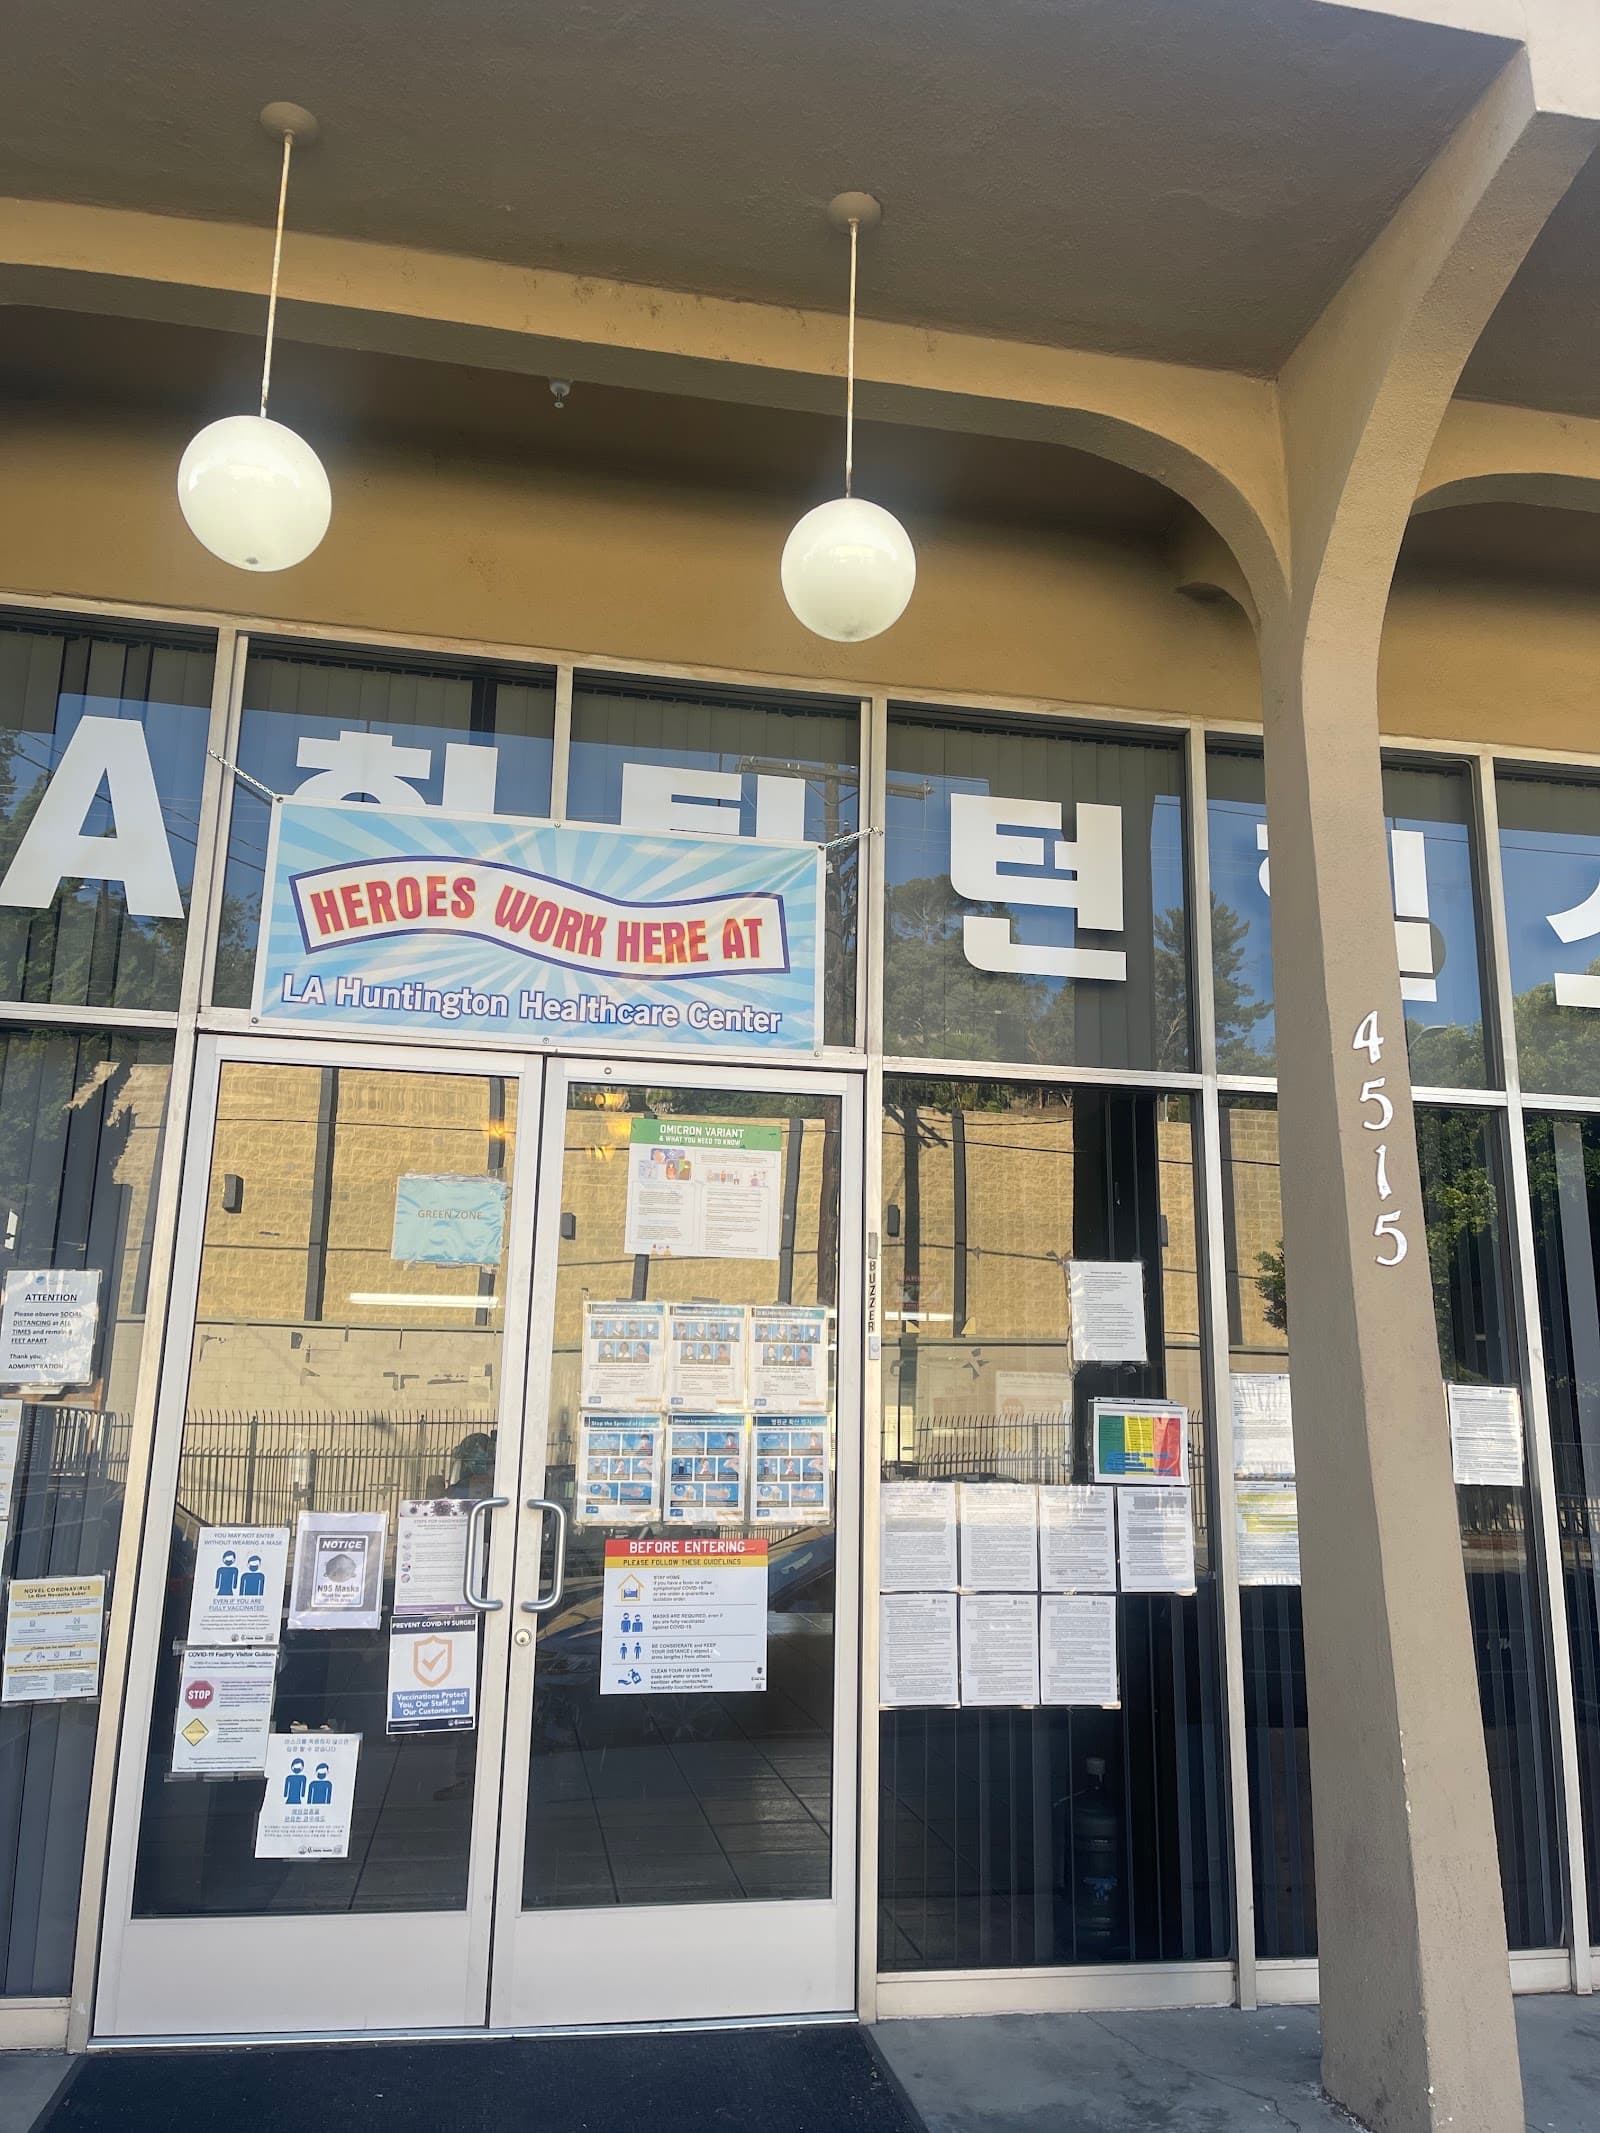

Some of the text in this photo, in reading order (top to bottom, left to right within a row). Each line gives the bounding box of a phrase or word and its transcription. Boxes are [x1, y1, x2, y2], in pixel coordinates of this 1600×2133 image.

[309, 875, 763, 965] HEROES WORK HERE AT
[281, 972, 782, 1034] LA Huntington Healthcare Center
[660, 1124, 745, 1138] OMICRON VARIANT
[1351, 1010, 1408, 1267] 4515
[417, 1209, 482, 1219] GREEN ZONE
[25, 1294, 77, 1302] ATTENTION
[868, 1261, 876, 1333] BUZZER
[322, 1541, 363, 1549] NOTICE
[629, 1541, 746, 1553] BEFORE ENTERING
[392, 1621, 420, 1629] PREVENT
[422, 1619, 451, 1627] COVID-19
[216, 1651, 235, 1659] Facility
[188, 1690, 211, 1699] STOP
[397, 1693, 439, 1701] Vaccinations
[418, 1707, 457, 1715] Customers.
